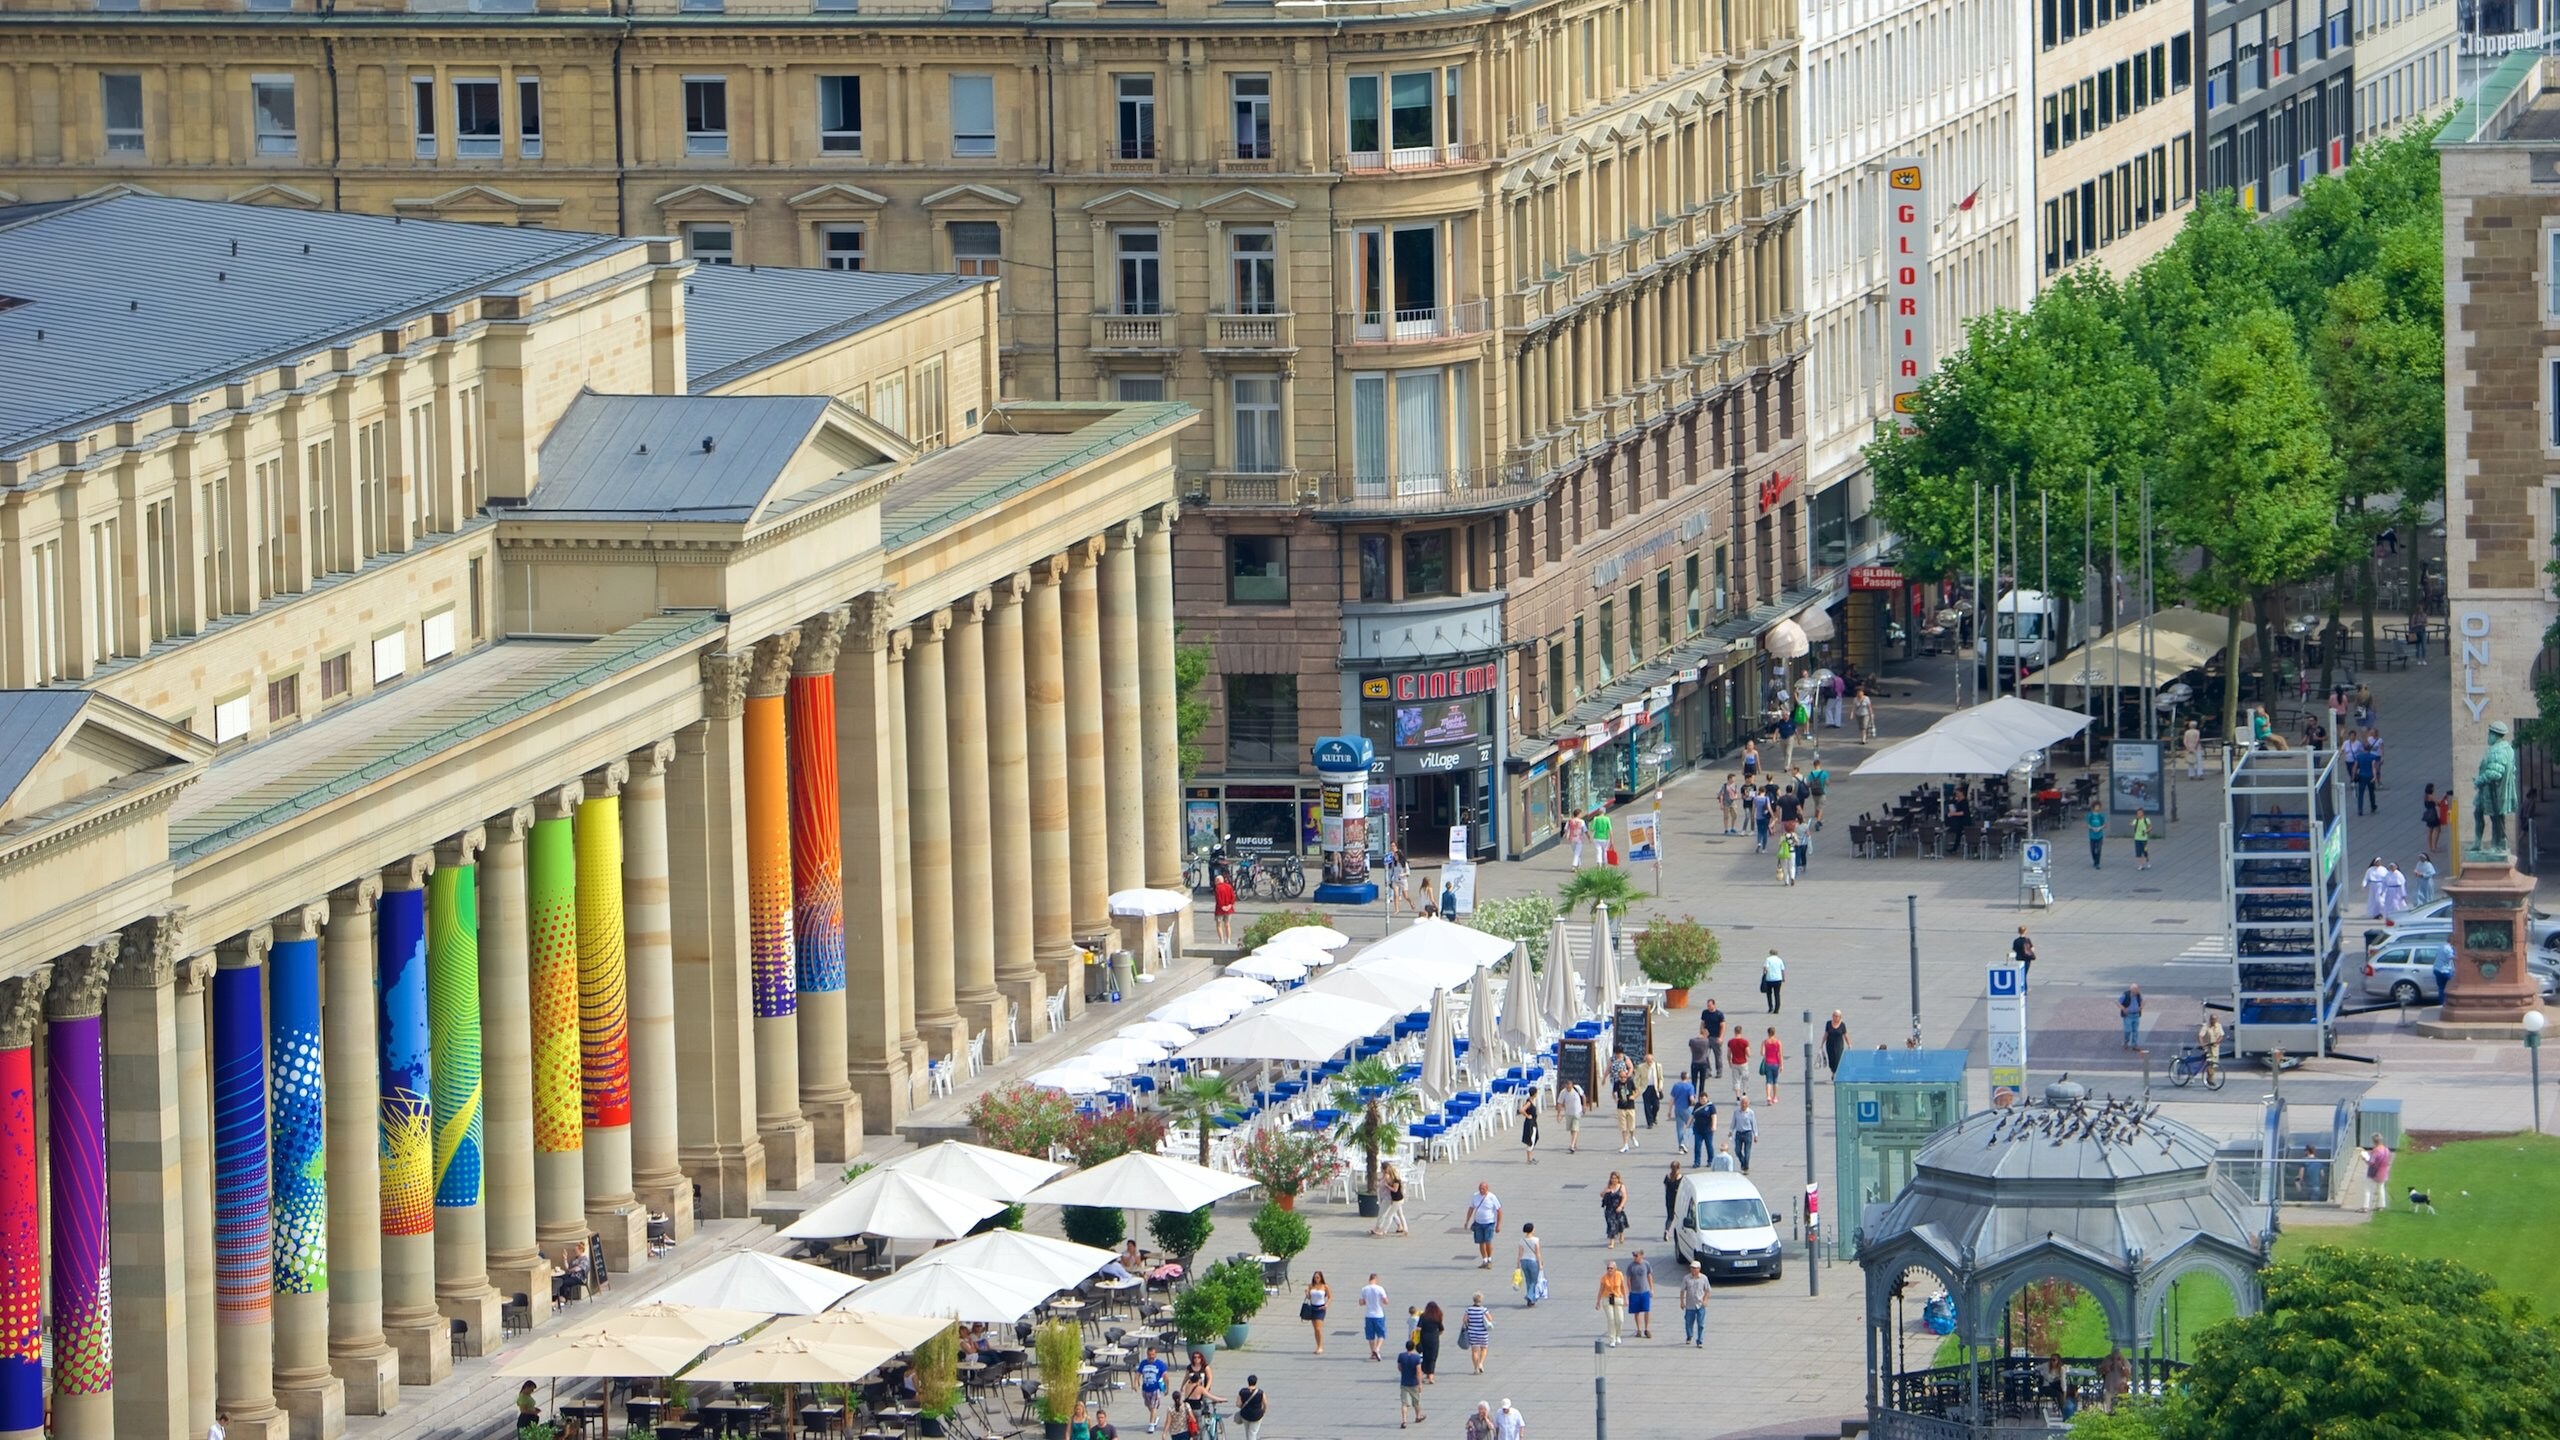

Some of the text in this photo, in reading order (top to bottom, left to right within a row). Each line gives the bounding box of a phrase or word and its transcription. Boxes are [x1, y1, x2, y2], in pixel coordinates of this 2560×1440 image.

[1898, 204, 1917, 377] GLORIA
[1863, 577, 1903, 589] Passage
[2459, 611, 2490, 723] ONLY
[1397, 663, 1497, 701] CINEMA
[1321, 754, 1352, 763] KULTUR
[1419, 752, 1460, 770] village
[1480, 750, 1489, 762] 22
[1371, 762, 1384, 773] 22
[1235, 837, 1273, 845] AUFGUSS
[1993, 971, 2012, 990] U
[1860, 1103, 1875, 1118] U
[99, 1267, 112, 1363] COLOURS
